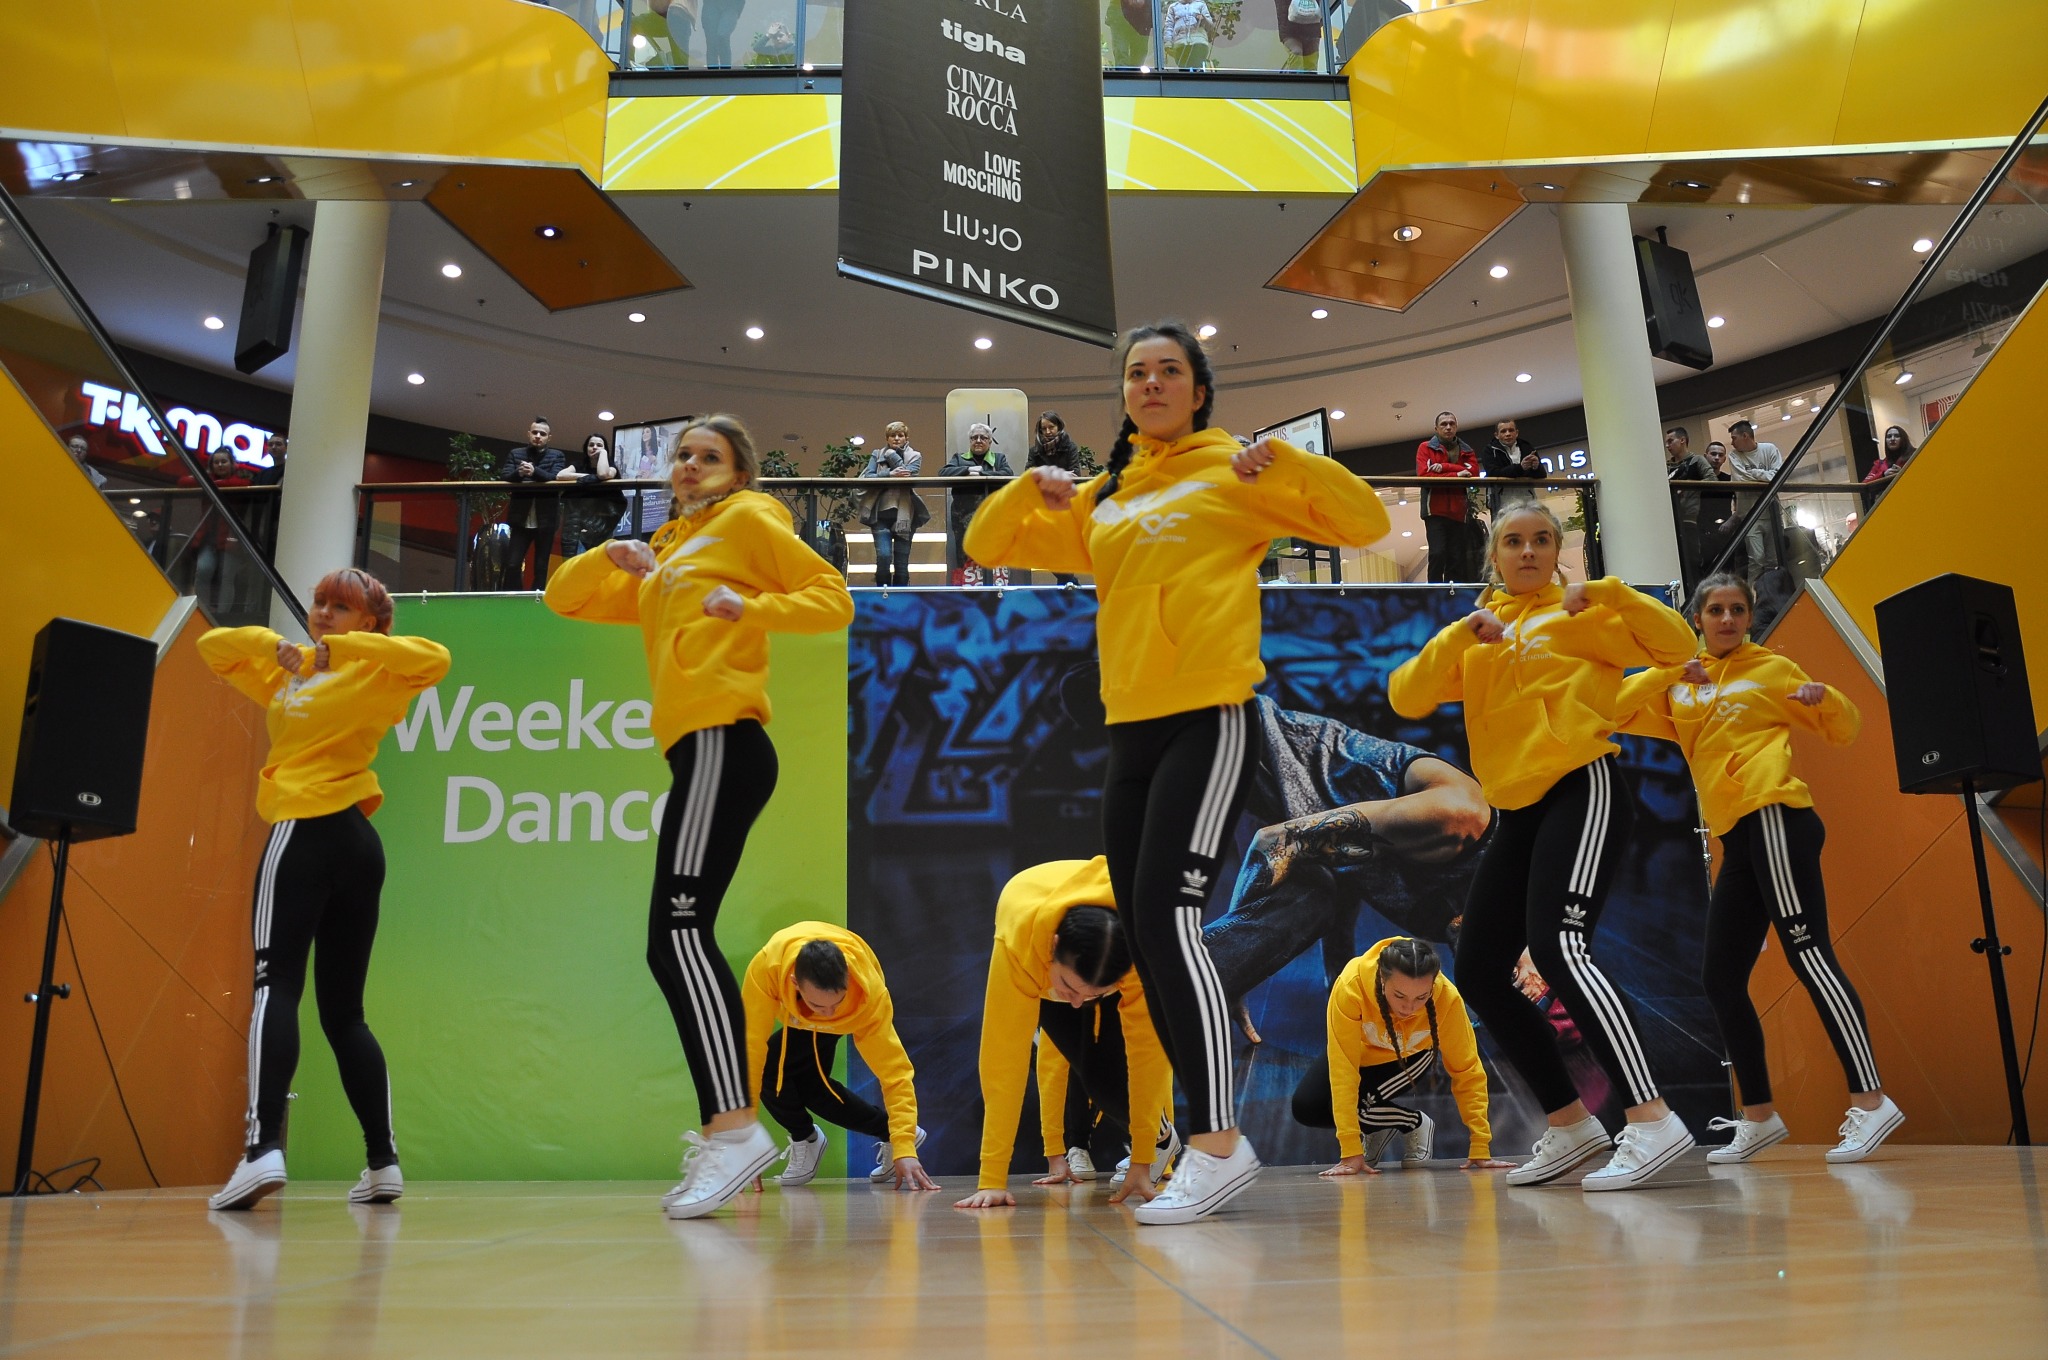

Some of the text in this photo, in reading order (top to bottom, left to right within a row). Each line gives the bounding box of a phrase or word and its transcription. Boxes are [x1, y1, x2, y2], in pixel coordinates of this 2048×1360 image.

[940, 18, 1027, 65] tigha
[946, 64, 1019, 110] CINZIA
[946, 89, 1019, 136] ROCCA
[943, 160, 1023, 203] MOSCHINO
[984, 150, 1022, 182] LOVE
[912, 248, 1060, 310] PINKO
[394, 678, 655, 752] Weeke
